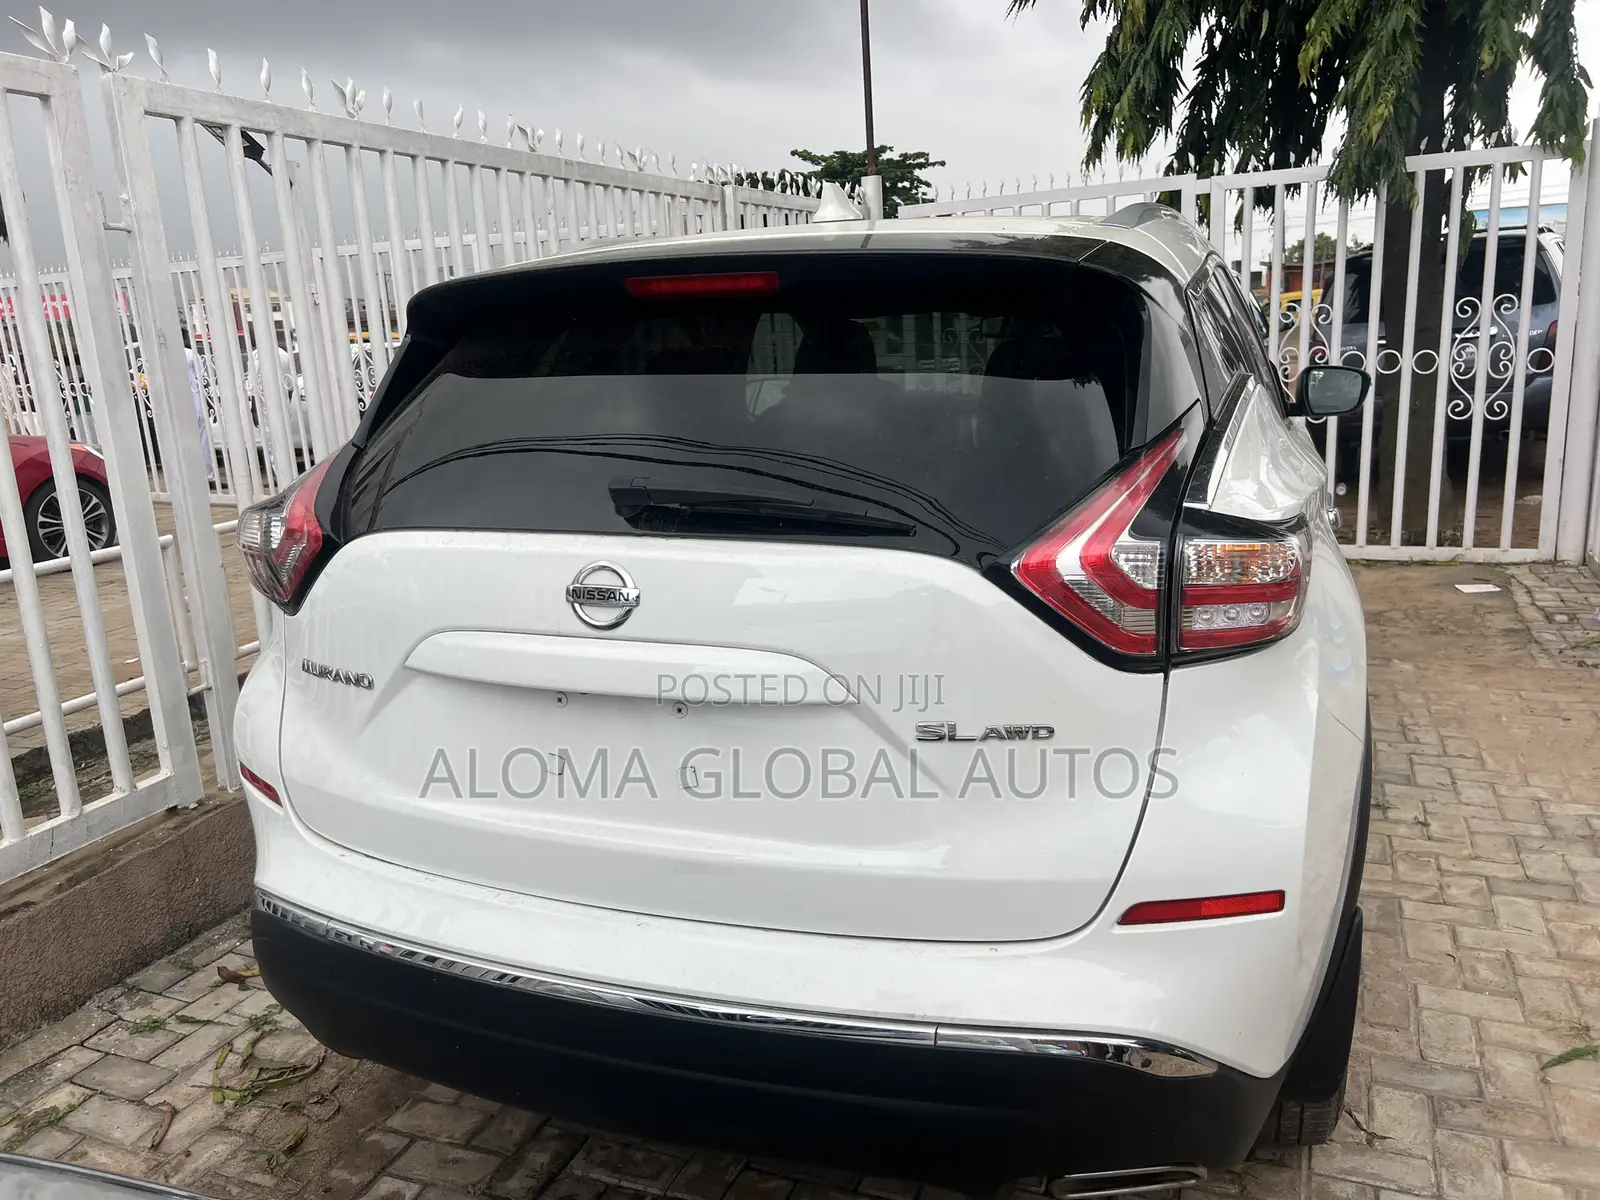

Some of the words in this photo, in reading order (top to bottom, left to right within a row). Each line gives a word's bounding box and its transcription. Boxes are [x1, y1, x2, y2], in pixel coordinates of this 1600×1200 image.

[571, 588, 629, 602] NISSAN
[915, 721, 978, 742] SL
[978, 723, 1055, 741] AWD
